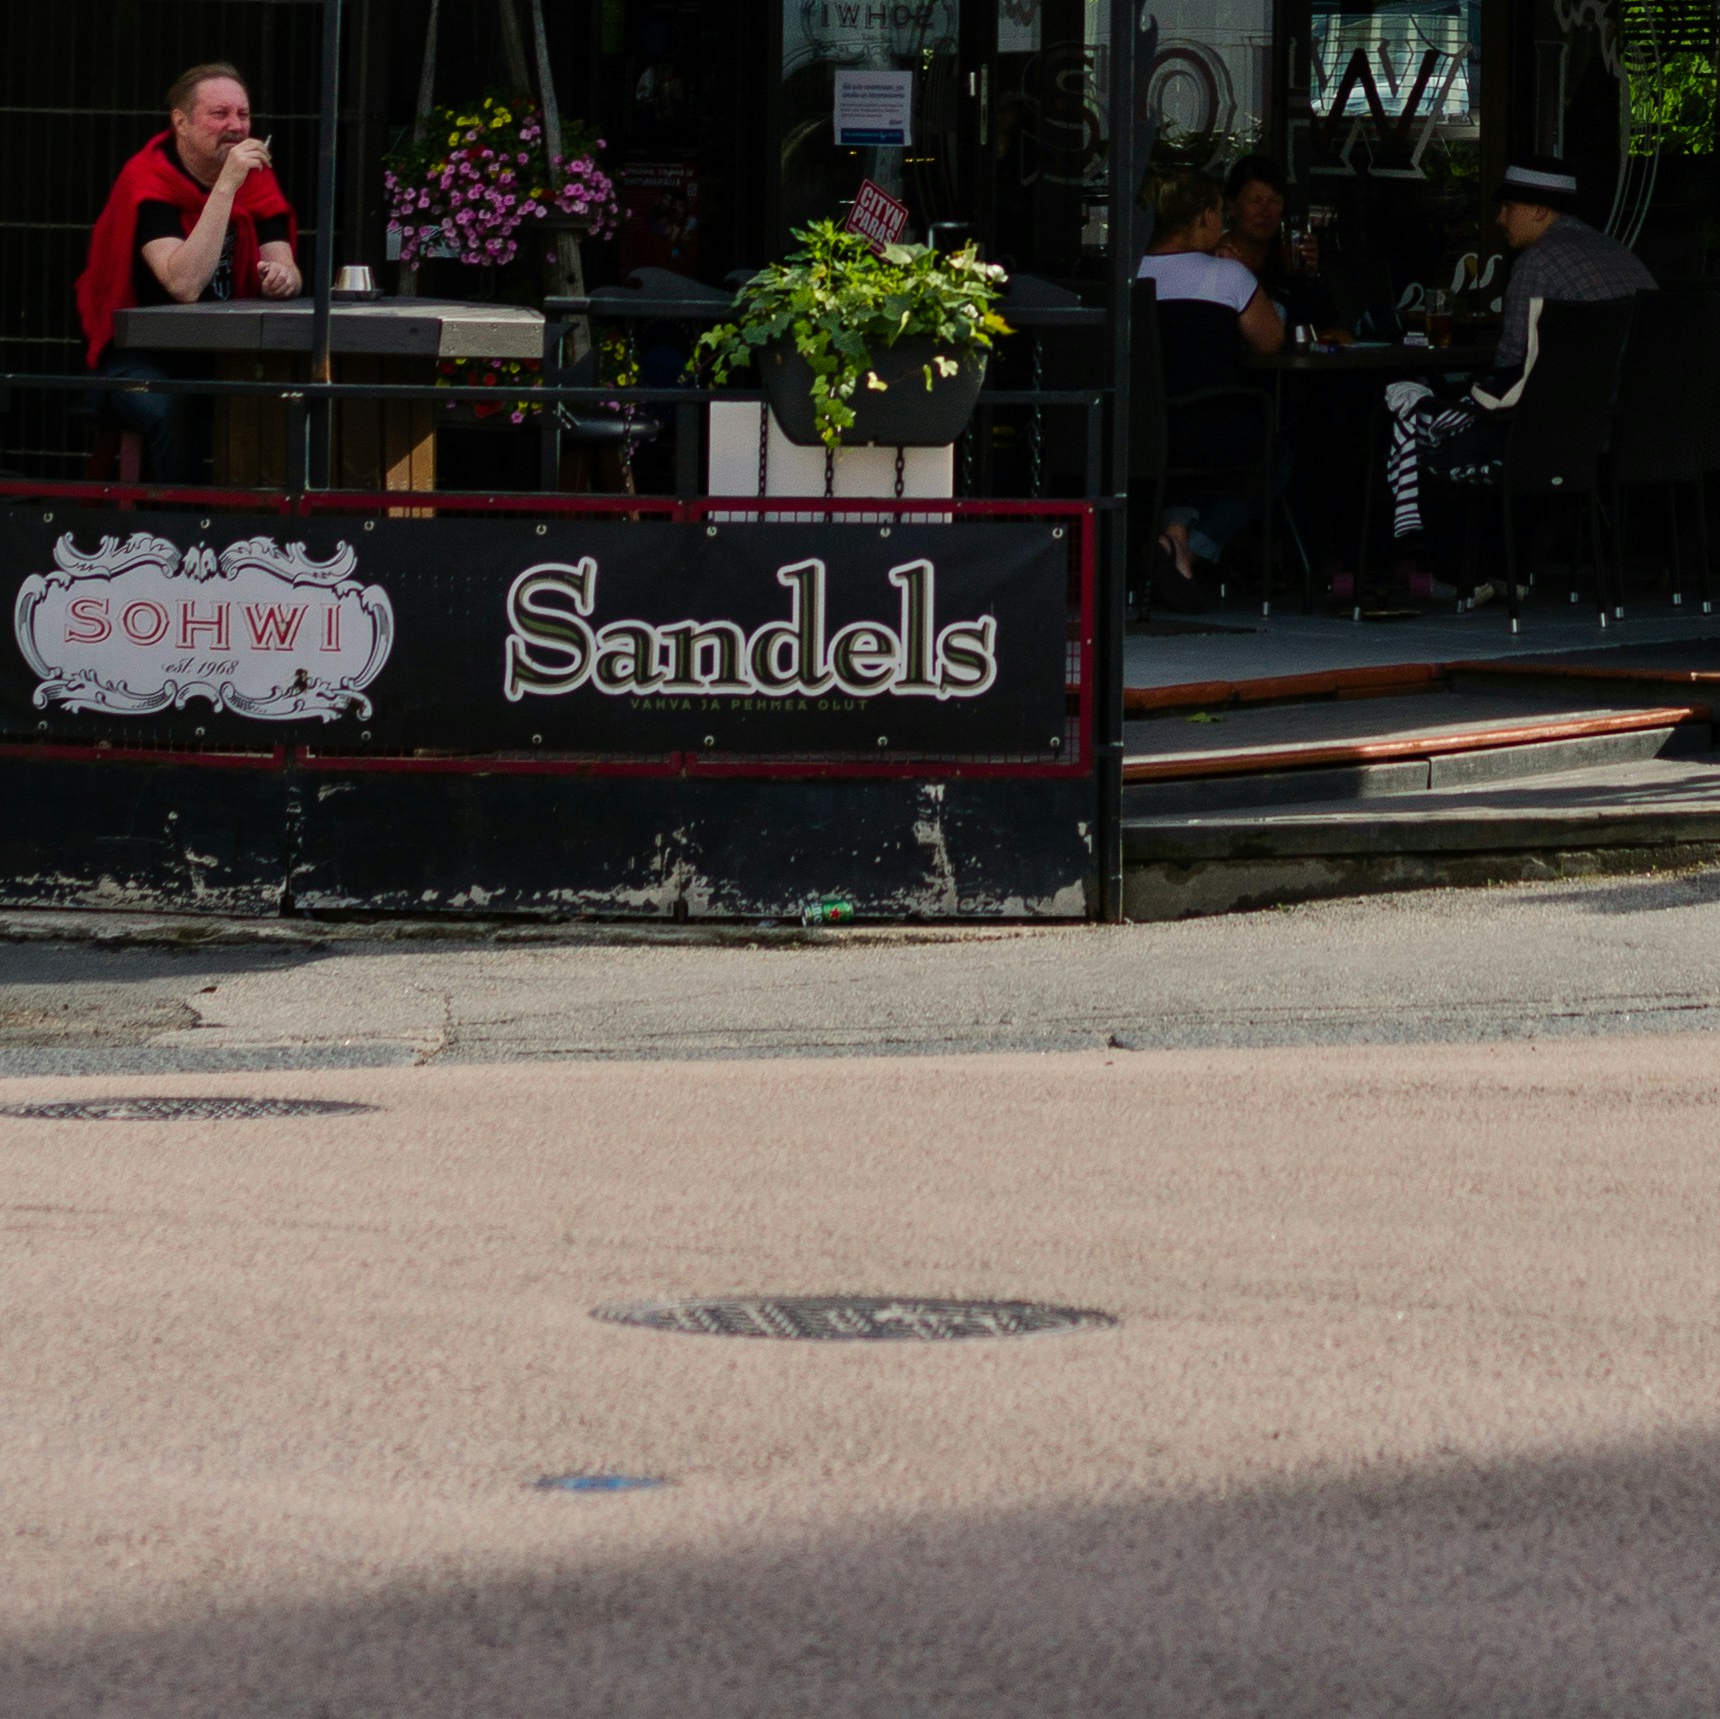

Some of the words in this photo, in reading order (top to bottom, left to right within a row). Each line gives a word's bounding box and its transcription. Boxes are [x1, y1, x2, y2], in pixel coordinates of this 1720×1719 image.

[851, 204, 896, 244] PARAS
[860, 186, 904, 232] CITYN
[64, 596, 343, 652] SOHWI
[503, 556, 997, 703] Sandels
[161, 656, 195, 674] est.
[197, 658, 240, 679] 1968
[630, 698, 692, 711] VAHVA
[700, 698, 721, 711] JA
[817, 698, 869, 711] OLUT
